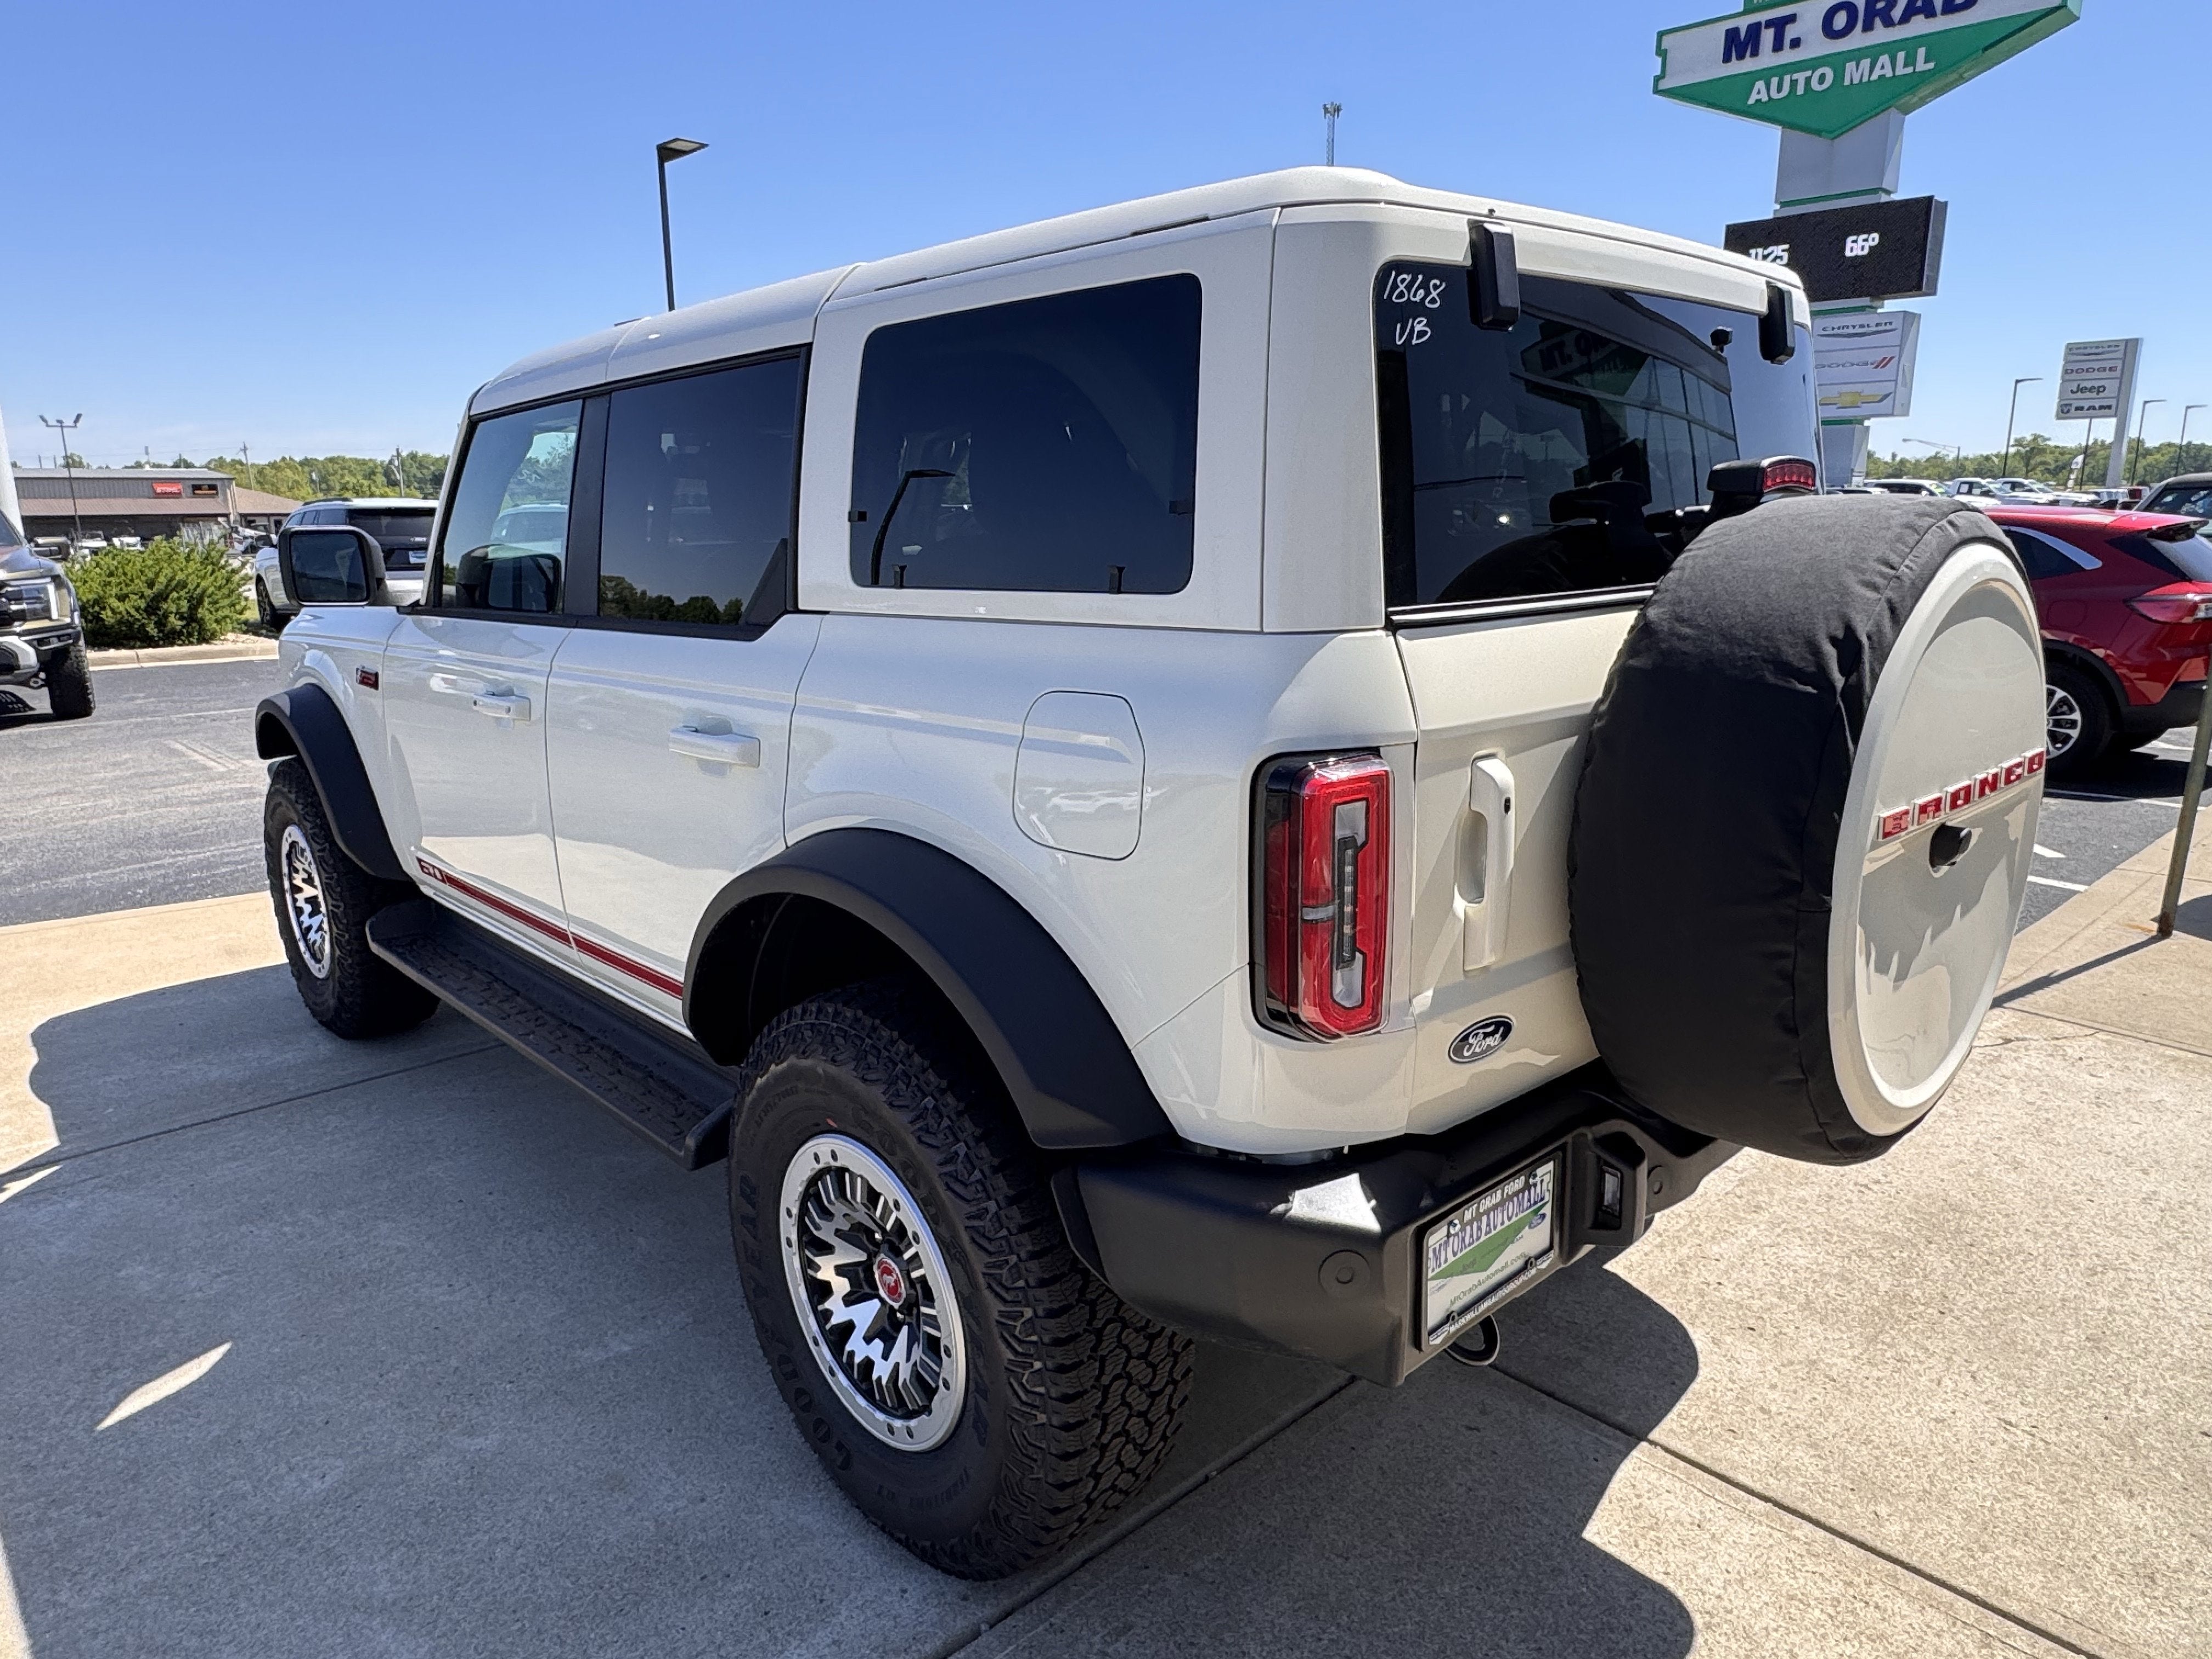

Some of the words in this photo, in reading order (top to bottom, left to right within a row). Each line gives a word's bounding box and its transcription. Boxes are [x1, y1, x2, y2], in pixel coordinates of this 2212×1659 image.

[1722, 13, 1802, 64] MT.
[1747, 66, 1833, 105] AUTO
[1843, 47, 1936, 86] MALL
[1384, 270, 1446, 308] 1868
[1821, 321, 1894, 331] CHRYSLER
[2065, 366, 2118, 374] DODGE
[2070, 383, 2107, 396] Jeep
[1877, 748, 2046, 840] BRONCO
[1464, 1203, 1479, 1223] MT
[1479, 1189, 1502, 1213] ORAB
[1503, 1175, 1526, 1199] FORD
[1431, 1240, 1449, 1273] MT
[1451, 1221, 1482, 1257] ORAB
